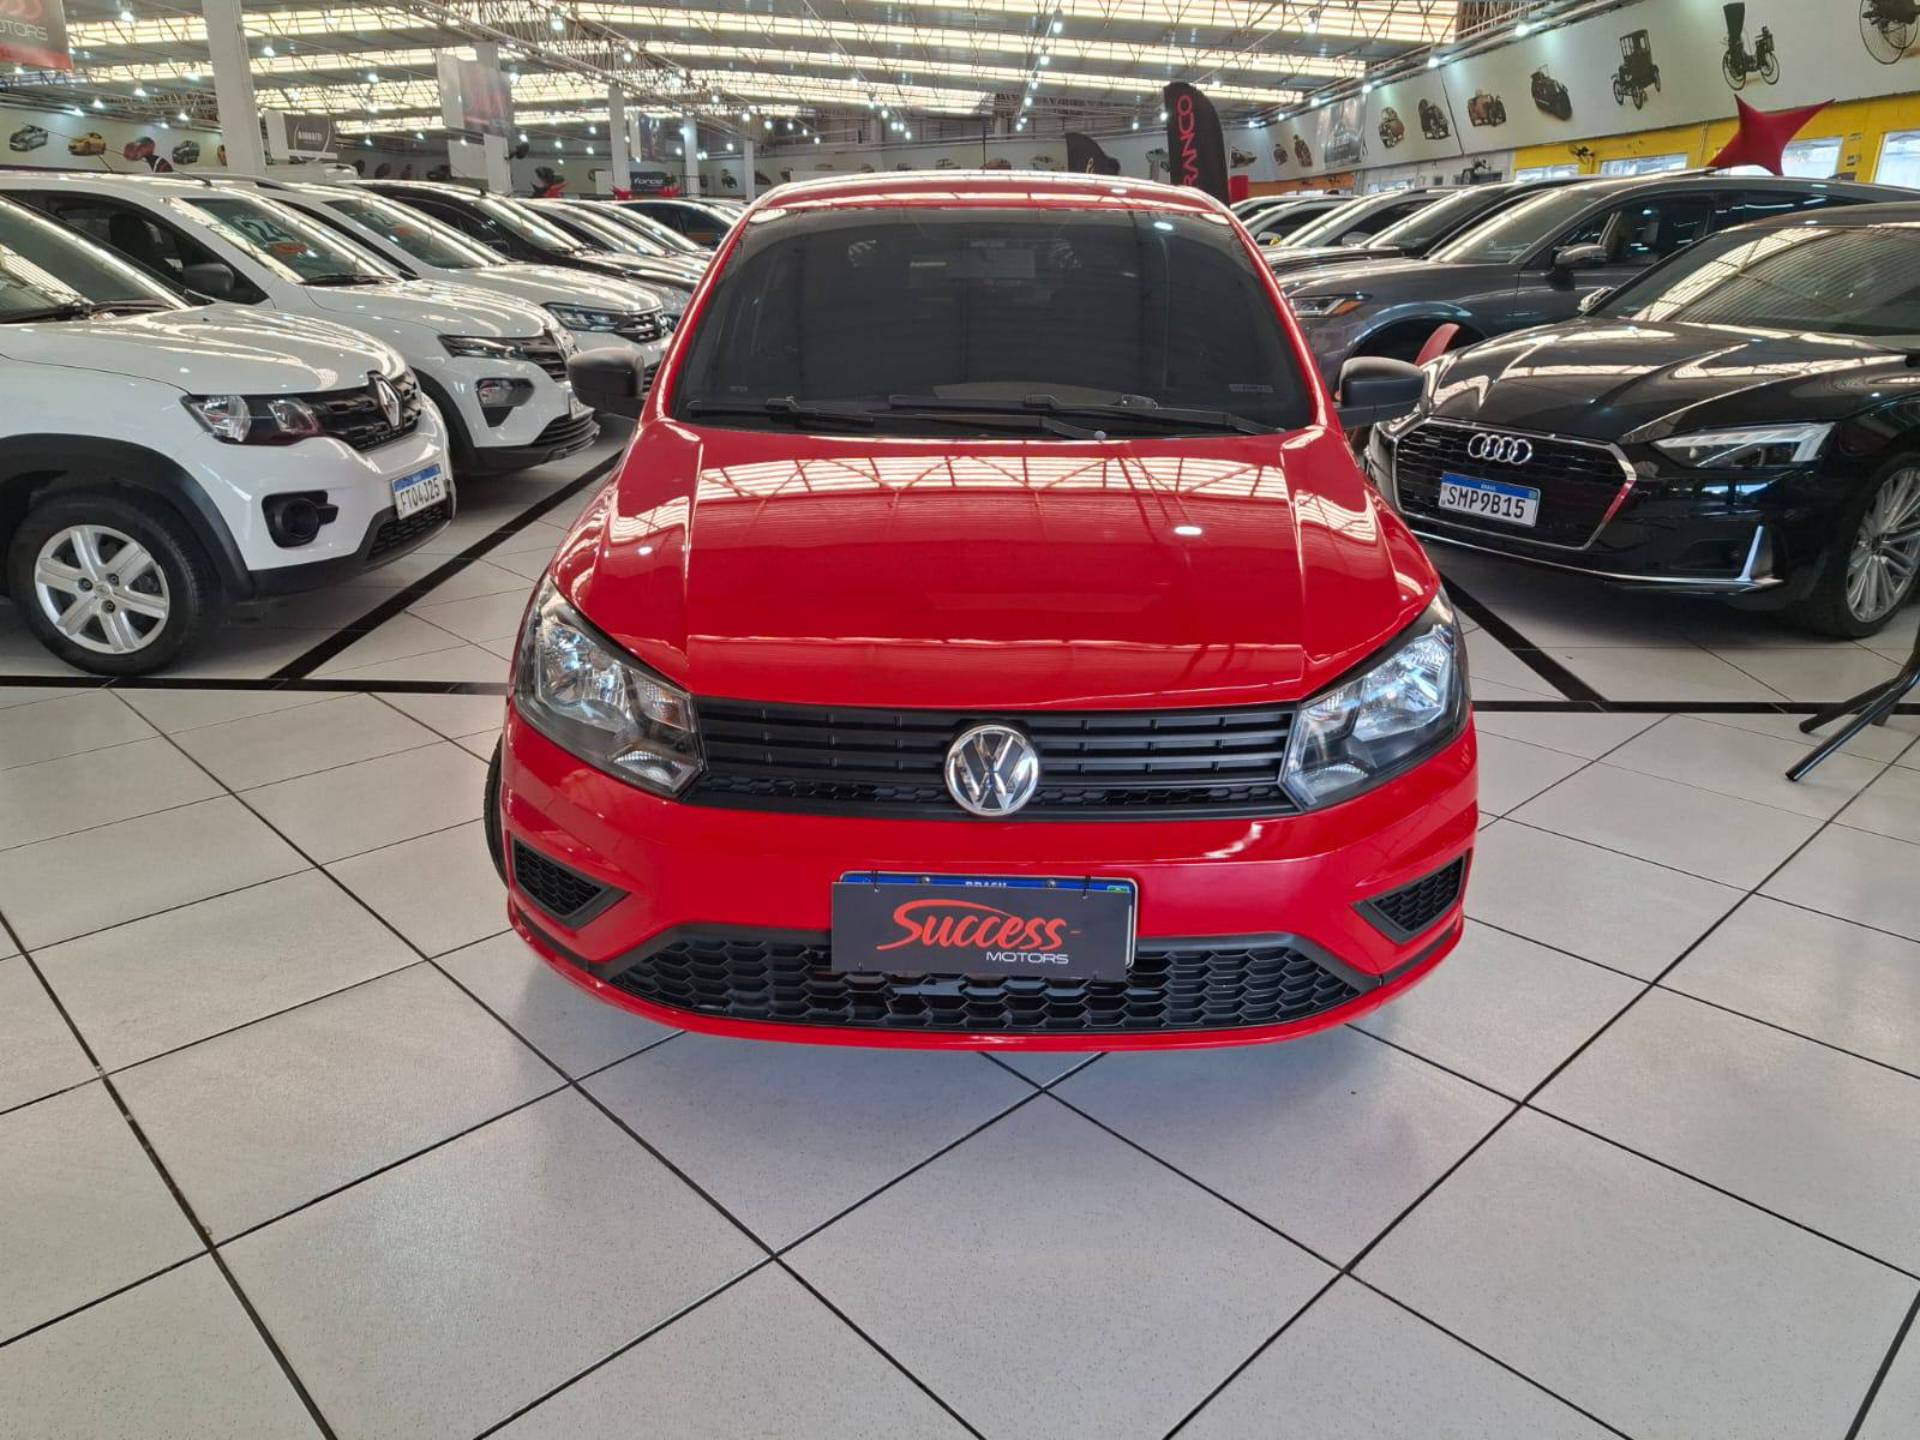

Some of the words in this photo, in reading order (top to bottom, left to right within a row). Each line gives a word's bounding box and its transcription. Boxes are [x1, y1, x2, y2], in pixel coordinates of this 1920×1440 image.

[1446, 486, 1527, 519] SMP9B15
[876, 898, 1067, 950] Success
[985, 951, 1069, 964] MOTORS
